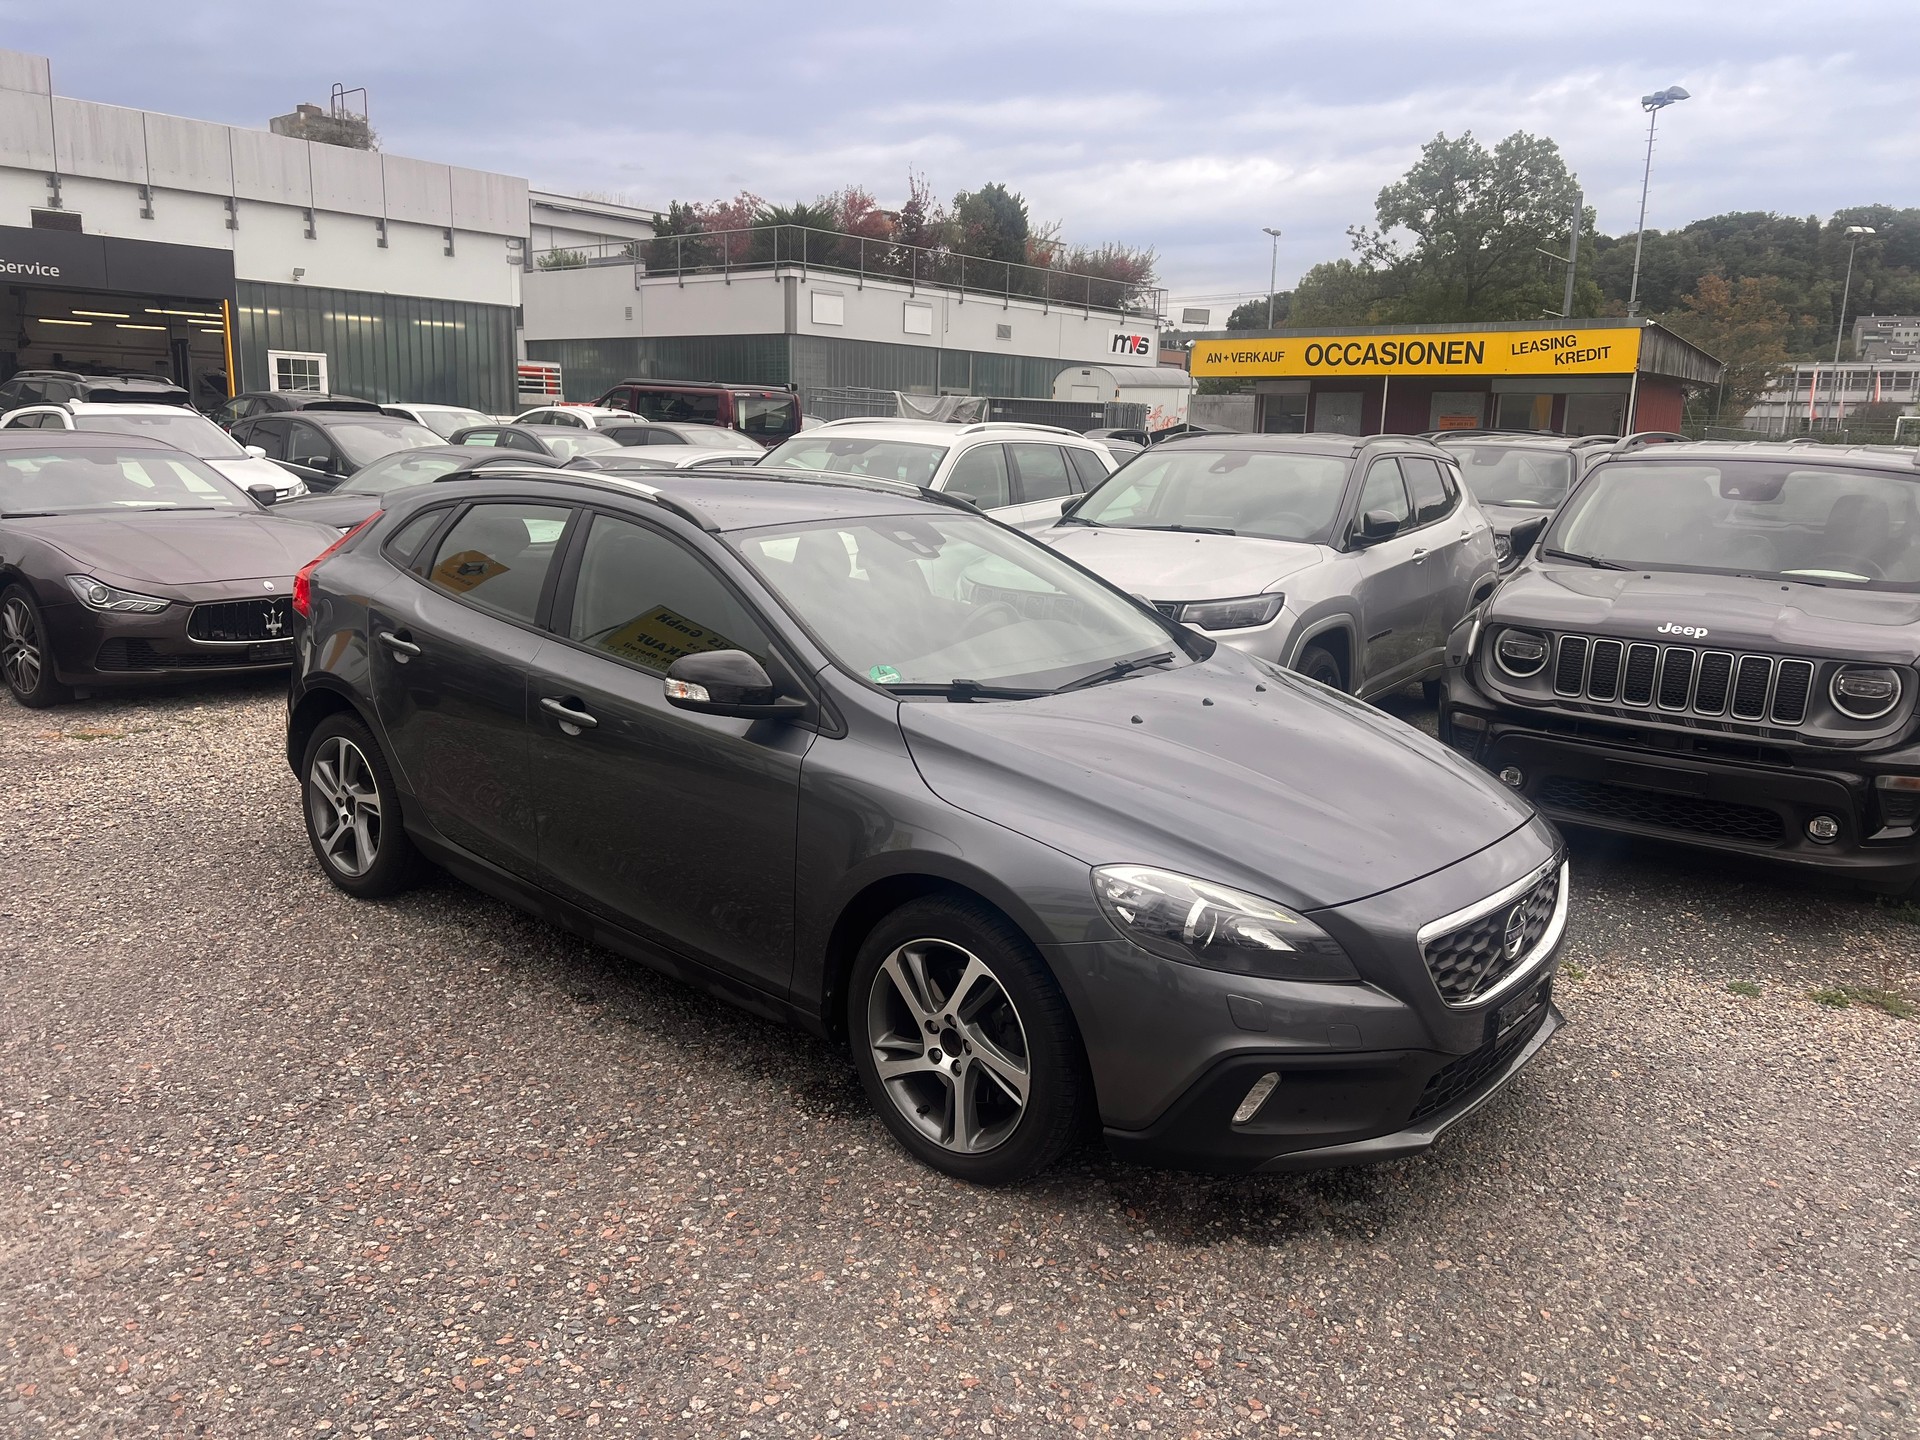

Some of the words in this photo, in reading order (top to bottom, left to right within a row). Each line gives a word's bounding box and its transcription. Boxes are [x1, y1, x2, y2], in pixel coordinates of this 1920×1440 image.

[0, 259, 60, 277] Service
[1304, 341, 1485, 367] OCCASIONEN
[1511, 334, 1577, 356] LEASING
[1554, 345, 1611, 366] KREDIT
[1657, 622, 1708, 639] Jeep
